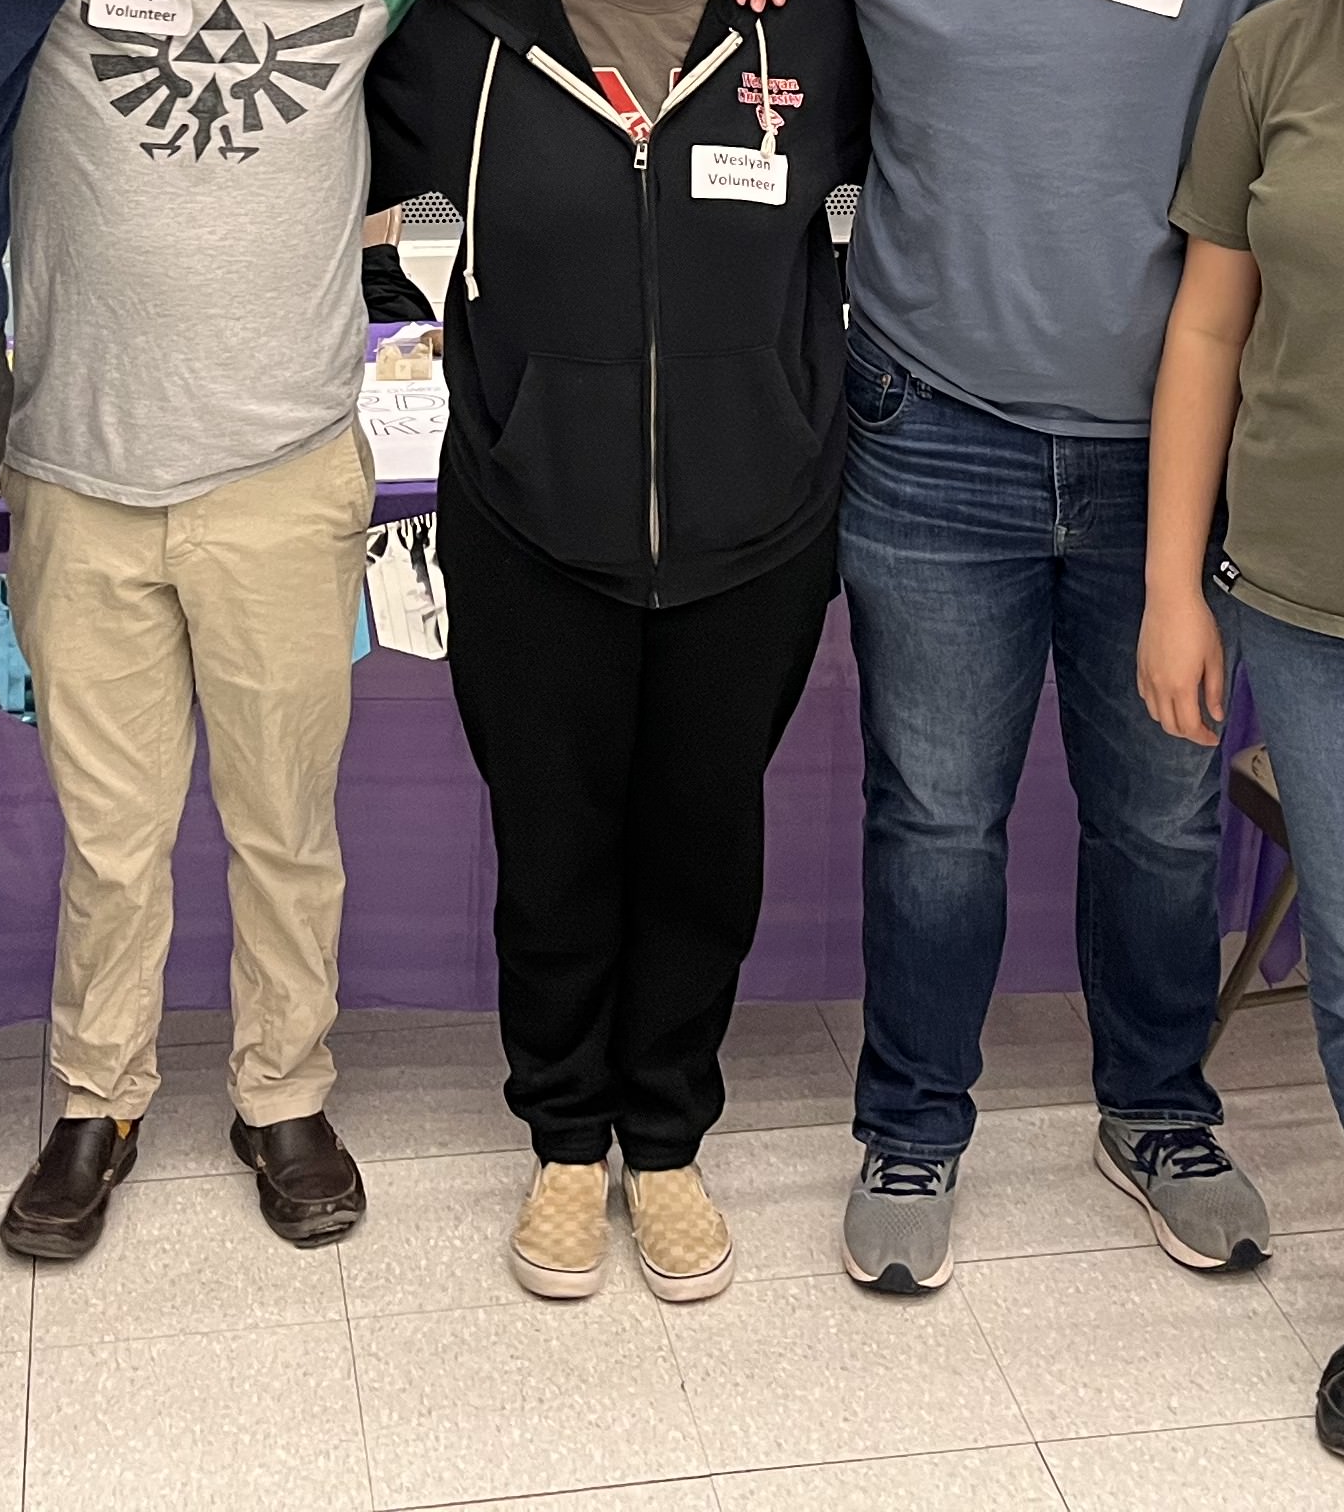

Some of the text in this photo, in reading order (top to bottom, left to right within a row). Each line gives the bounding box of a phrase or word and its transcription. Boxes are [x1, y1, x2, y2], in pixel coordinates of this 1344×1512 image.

[105, 4, 177, 22] Volunteer
[713, 152, 771, 171] Weslyan
[708, 173, 776, 192] Volunteer
